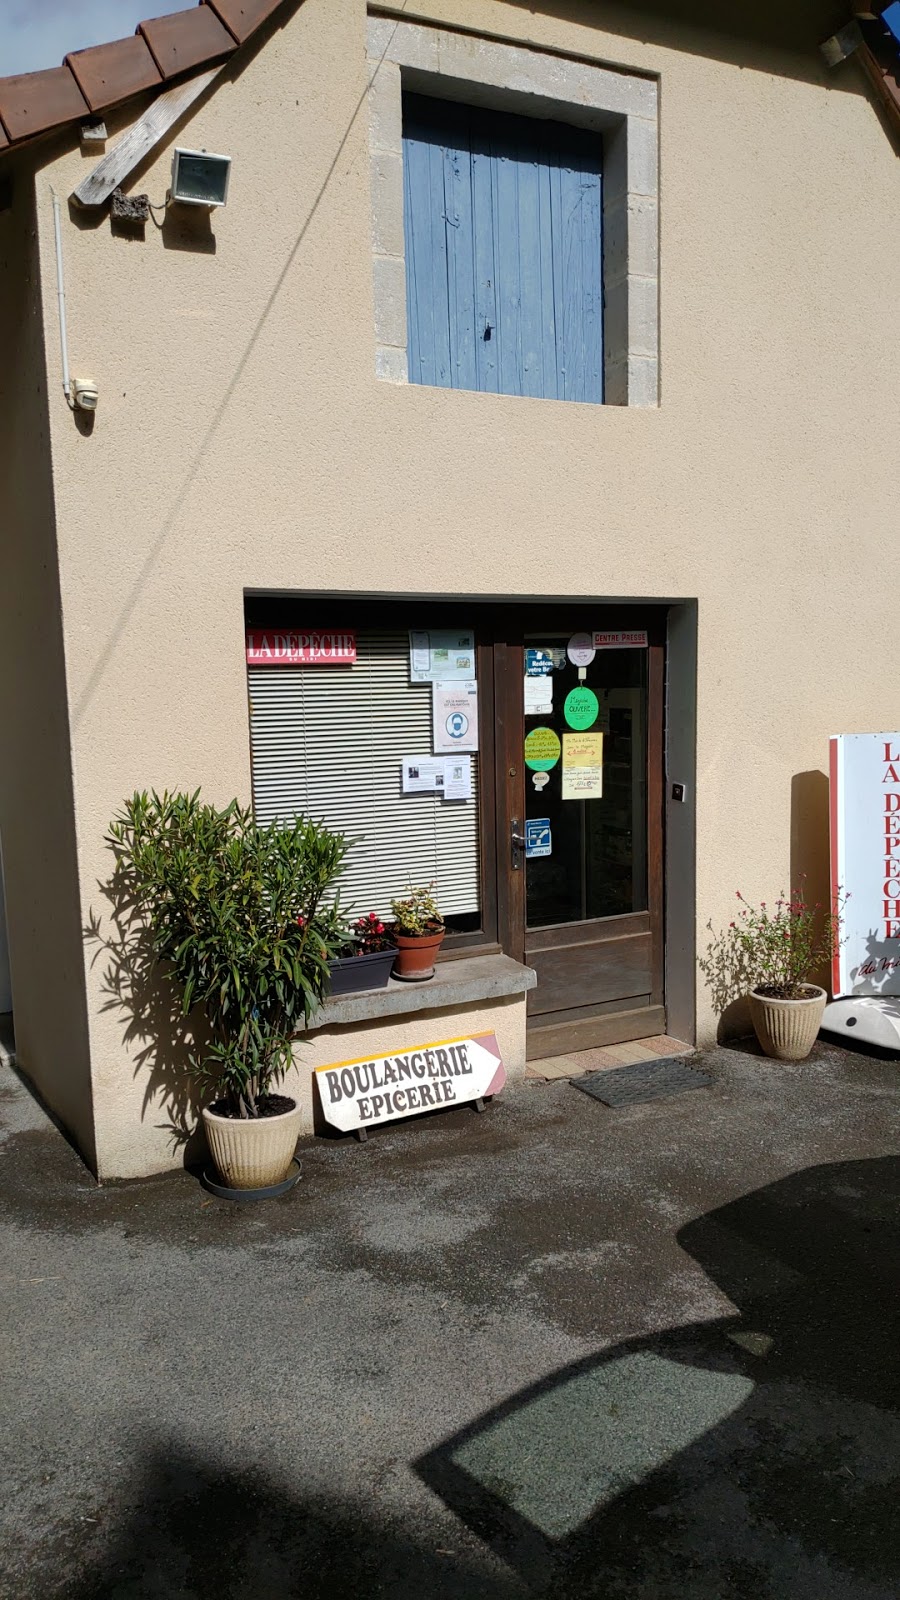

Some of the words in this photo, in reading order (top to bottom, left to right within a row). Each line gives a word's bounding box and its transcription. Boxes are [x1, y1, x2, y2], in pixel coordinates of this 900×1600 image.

[247, 634, 273, 658] LA
[273, 631, 355, 658] DÉPÊCHE
[595, 633, 619, 642] CENTRE
[621, 633, 646, 642] PRESSE
[325, 1044, 473, 1104] BOULANGERIE
[356, 1079, 456, 1121] EPICERIE
